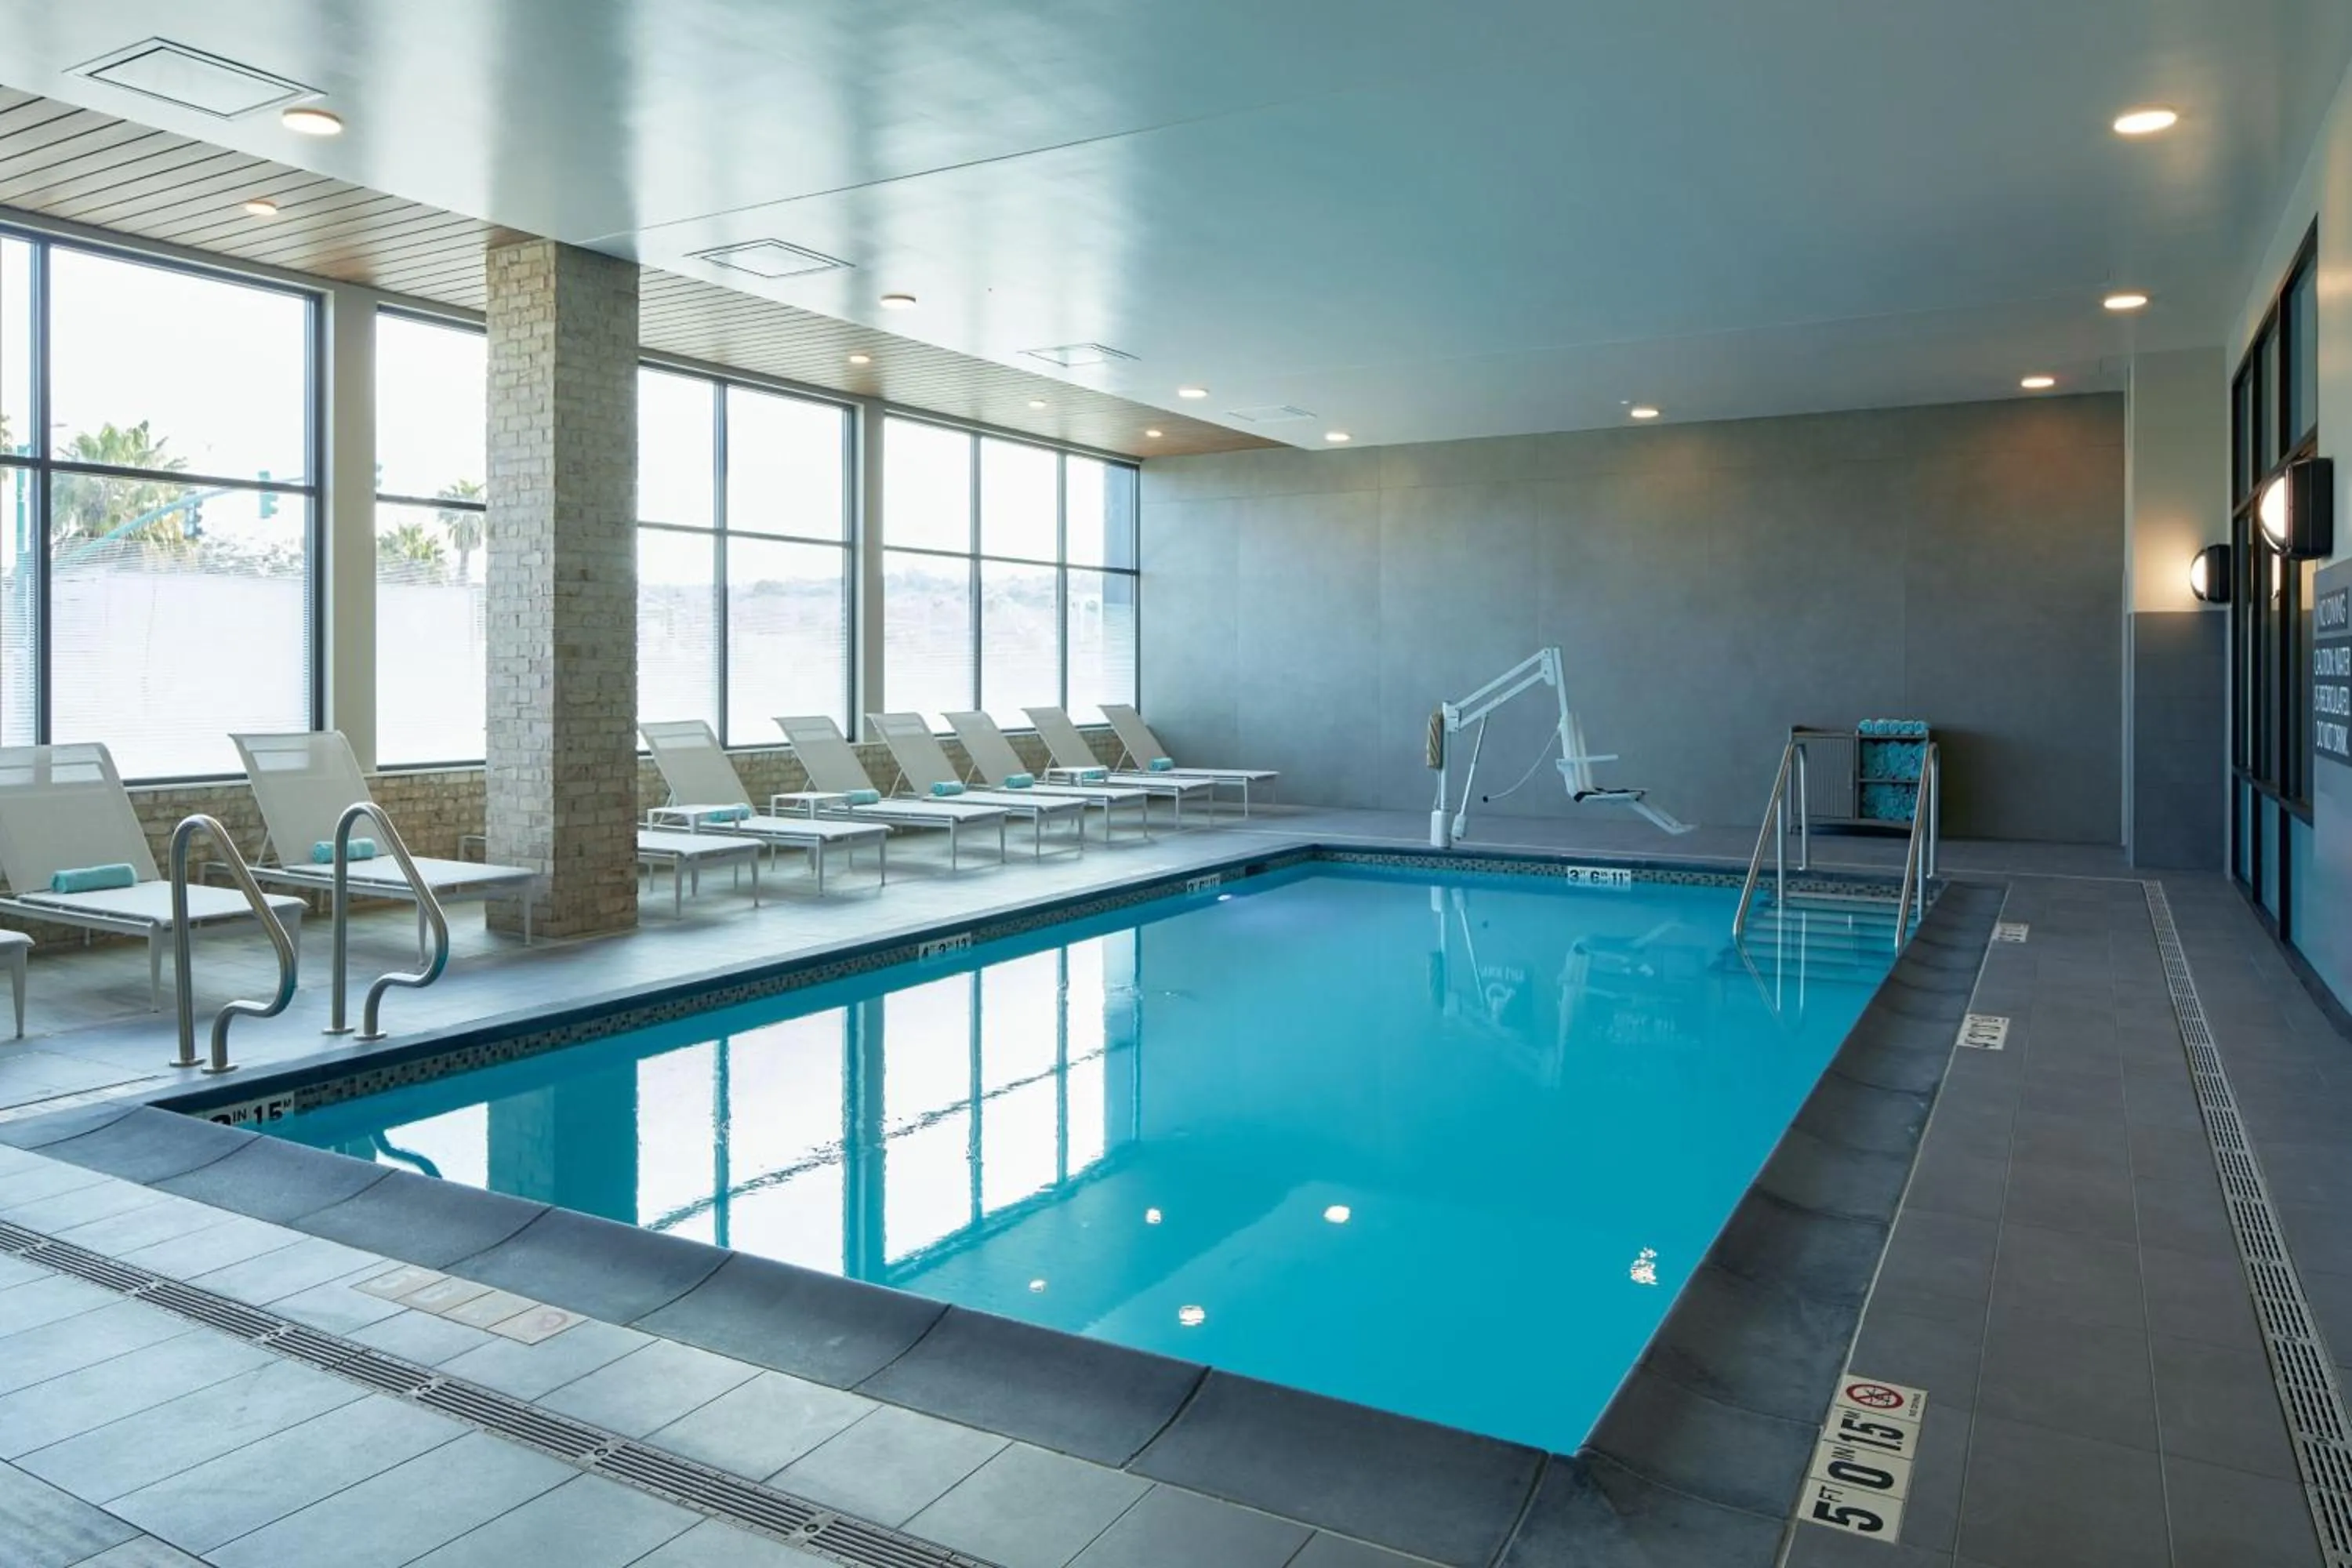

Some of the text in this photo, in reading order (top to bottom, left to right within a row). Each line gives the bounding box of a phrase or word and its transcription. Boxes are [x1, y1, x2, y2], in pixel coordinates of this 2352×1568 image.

[232, 1108, 247, 1123] IN
[1819, 1485, 1844, 1503] FT
[1813, 1501, 1884, 1533] 5
